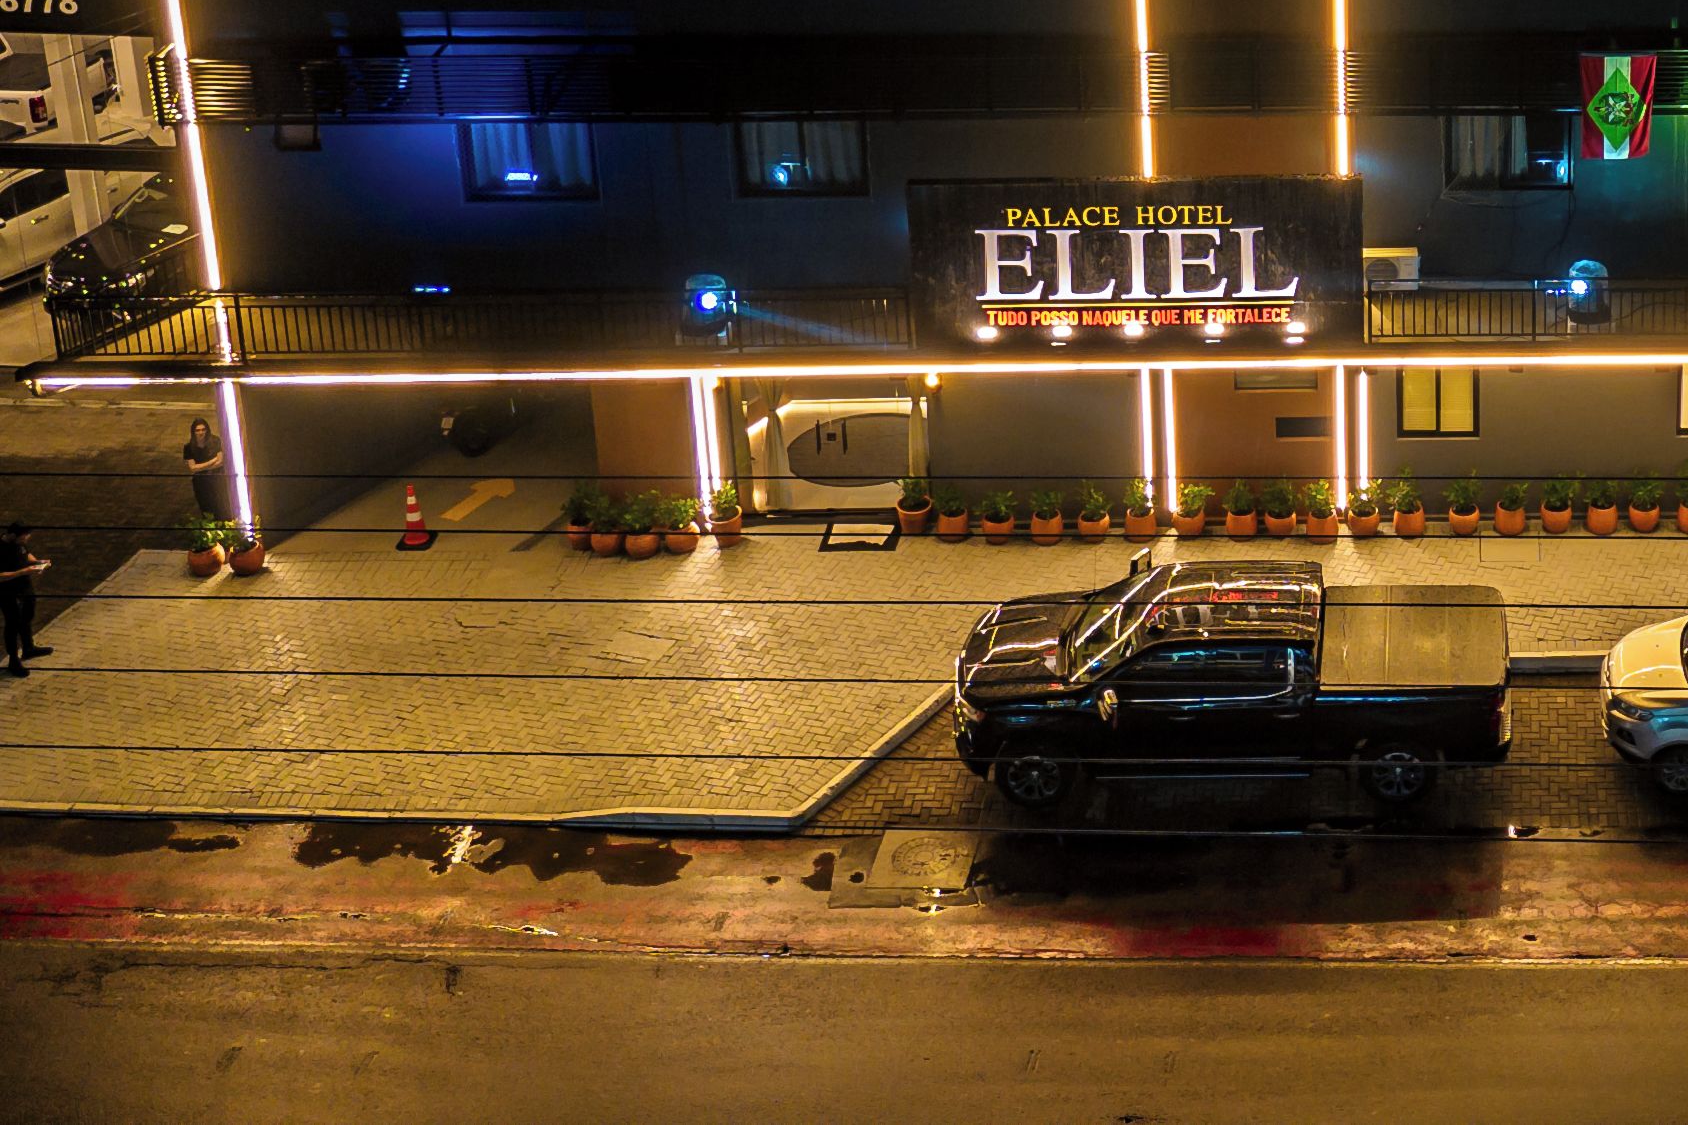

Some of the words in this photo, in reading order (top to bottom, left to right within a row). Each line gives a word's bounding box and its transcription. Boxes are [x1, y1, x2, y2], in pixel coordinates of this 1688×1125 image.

[1005, 205, 1121, 227] PALACE
[1135, 204, 1233, 226] HOTEL
[975, 226, 1299, 301] ELIEL
[987, 310, 1028, 326] TUDO
[1031, 310, 1079, 326] POSSO
[1082, 309, 1150, 327] NAQUELE
[1151, 309, 1181, 326] QUE
[1183, 308, 1205, 325] ME
[1207, 306, 1291, 325] FORTALECE
